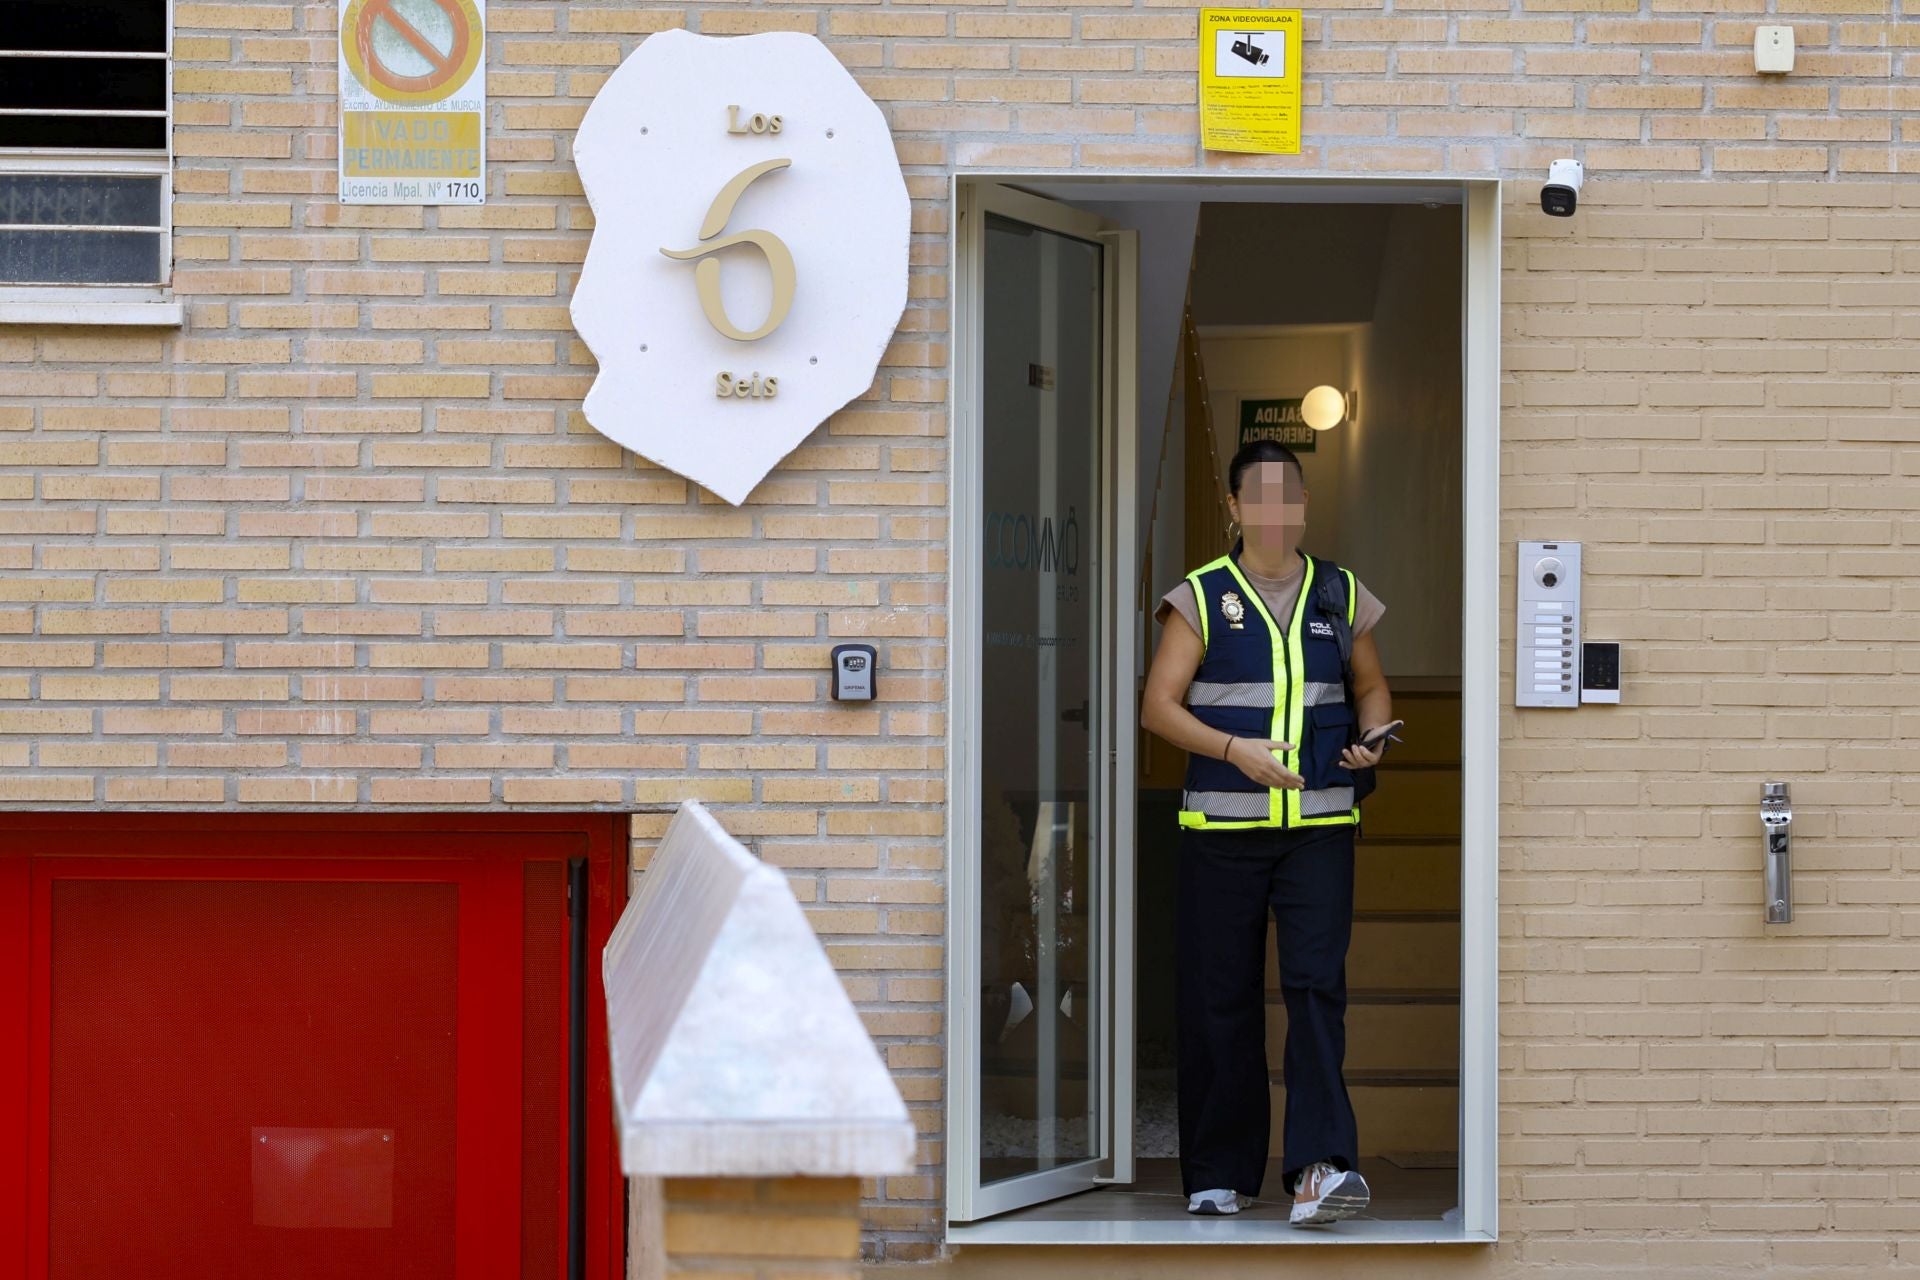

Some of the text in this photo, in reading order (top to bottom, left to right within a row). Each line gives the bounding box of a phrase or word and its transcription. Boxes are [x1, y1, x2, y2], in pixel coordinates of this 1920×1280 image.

[437, 100, 448, 110] DE
[451, 100, 481, 110] MURCIA
[376, 119, 449, 141] VADO
[727, 104, 783, 134] Los
[344, 148, 480, 170] PERMANENTE
[342, 183, 387, 197] Licencia
[393, 183, 422, 199] Mpal.
[446, 183, 479, 198] 1710
[659, 158, 796, 341] 6
[715, 371, 779, 398] Seis
